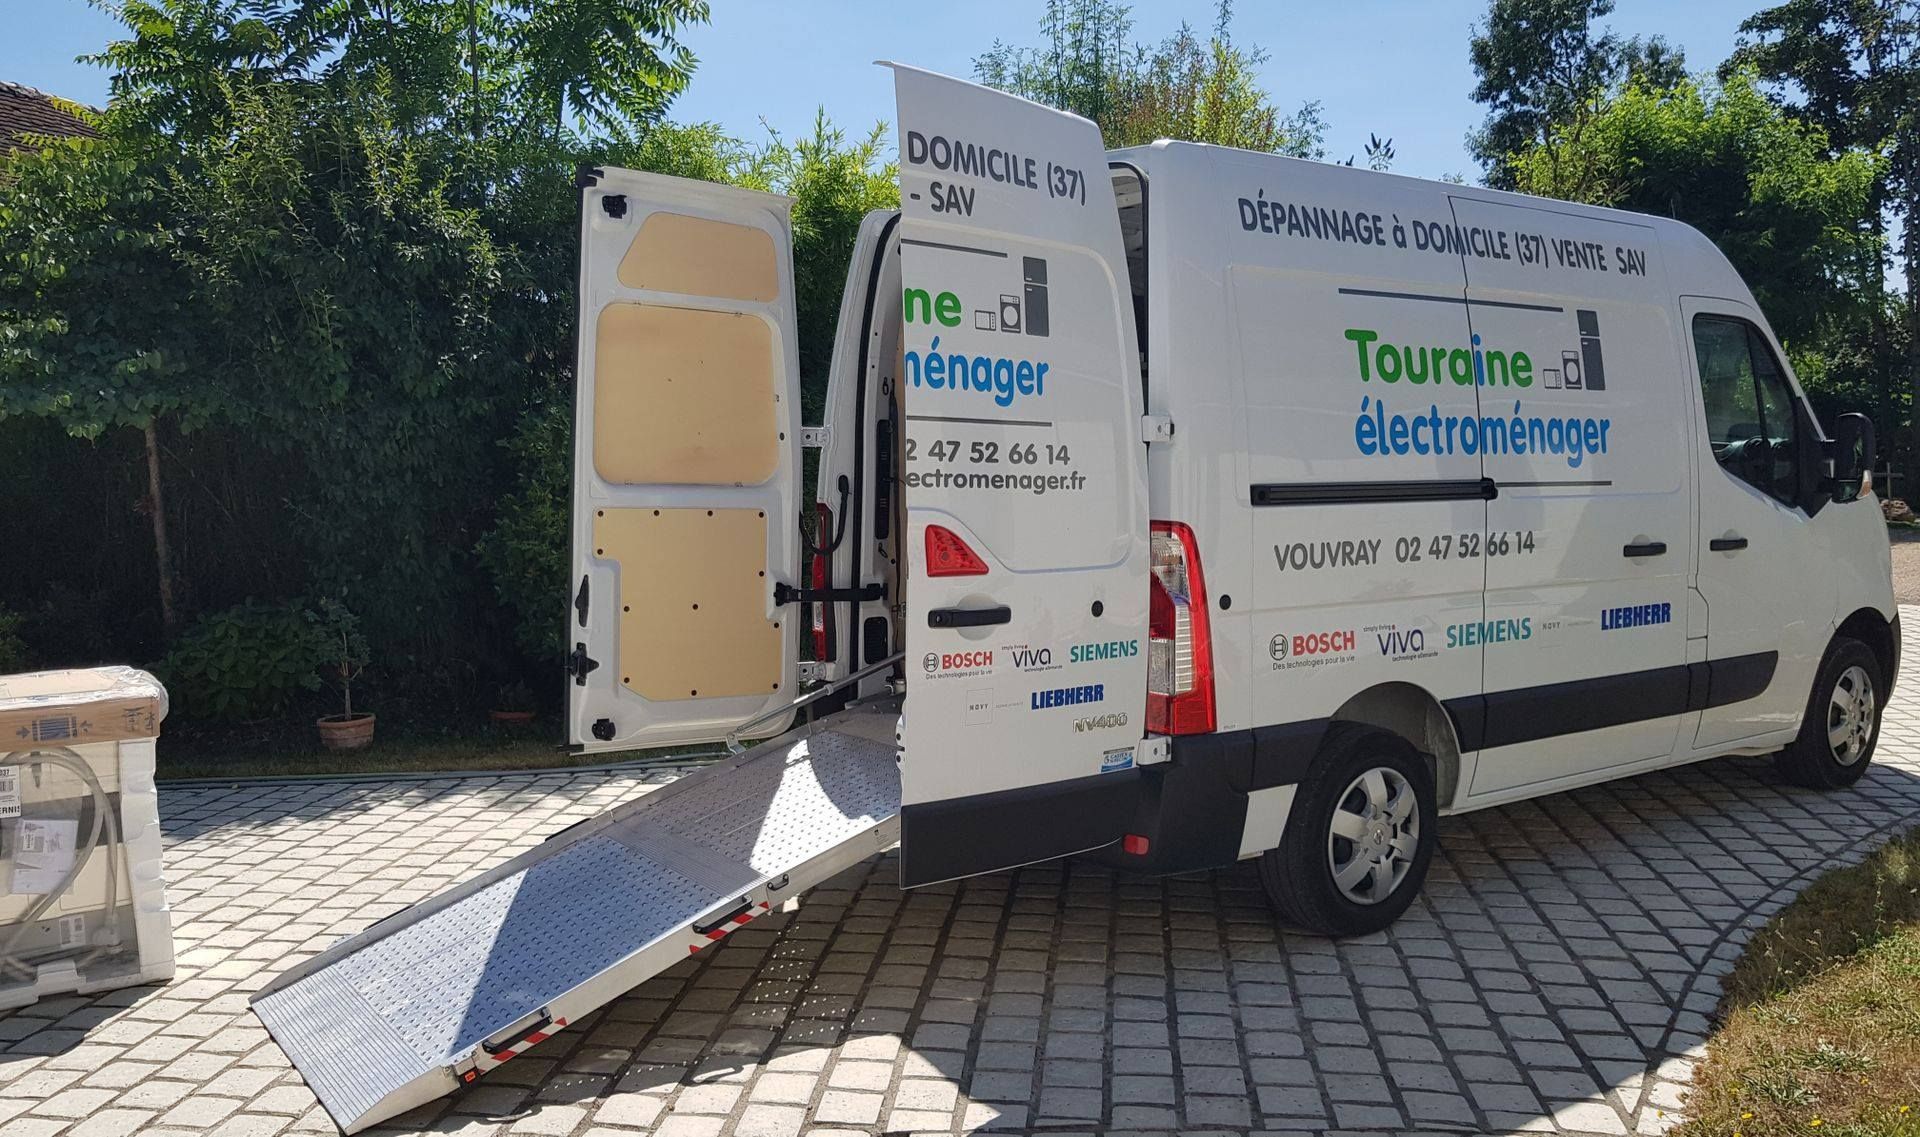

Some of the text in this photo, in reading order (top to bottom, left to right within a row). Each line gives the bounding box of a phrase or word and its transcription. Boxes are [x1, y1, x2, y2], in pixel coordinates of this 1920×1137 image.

[907, 131, 1086, 206] DOMICILE (37)
[930, 181, 975, 217] SAV
[1238, 189, 1647, 277] DÉPANNAGE à DOMICILE (37) VENTE SAV
[904, 287, 962, 327] ne
[1344, 329, 1533, 387] Touraine
[1355, 395, 1610, 468] électroménager
[928, 440, 961, 463] 47
[969, 442, 999, 464] 52
[1008, 443, 1038, 465] 66
[1046, 445, 1070, 466] 14
[906, 469, 1086, 495] ectromenager.fr
[1274, 530, 1535, 571] VOUVRAY 02 47 52 66 14
[1601, 602, 1671, 631] LIEBHERR
[1292, 631, 1355, 656] BOSCH
[1446, 617, 1532, 648] SIEMENS
[942, 651, 993, 670] BOSCH
[1070, 640, 1138, 663] SIEMENS
[1272, 654, 1355, 671] Des technologies pour la vie
[1031, 684, 1104, 710] LIEBHERR
[1073, 713, 1127, 733] NV400
